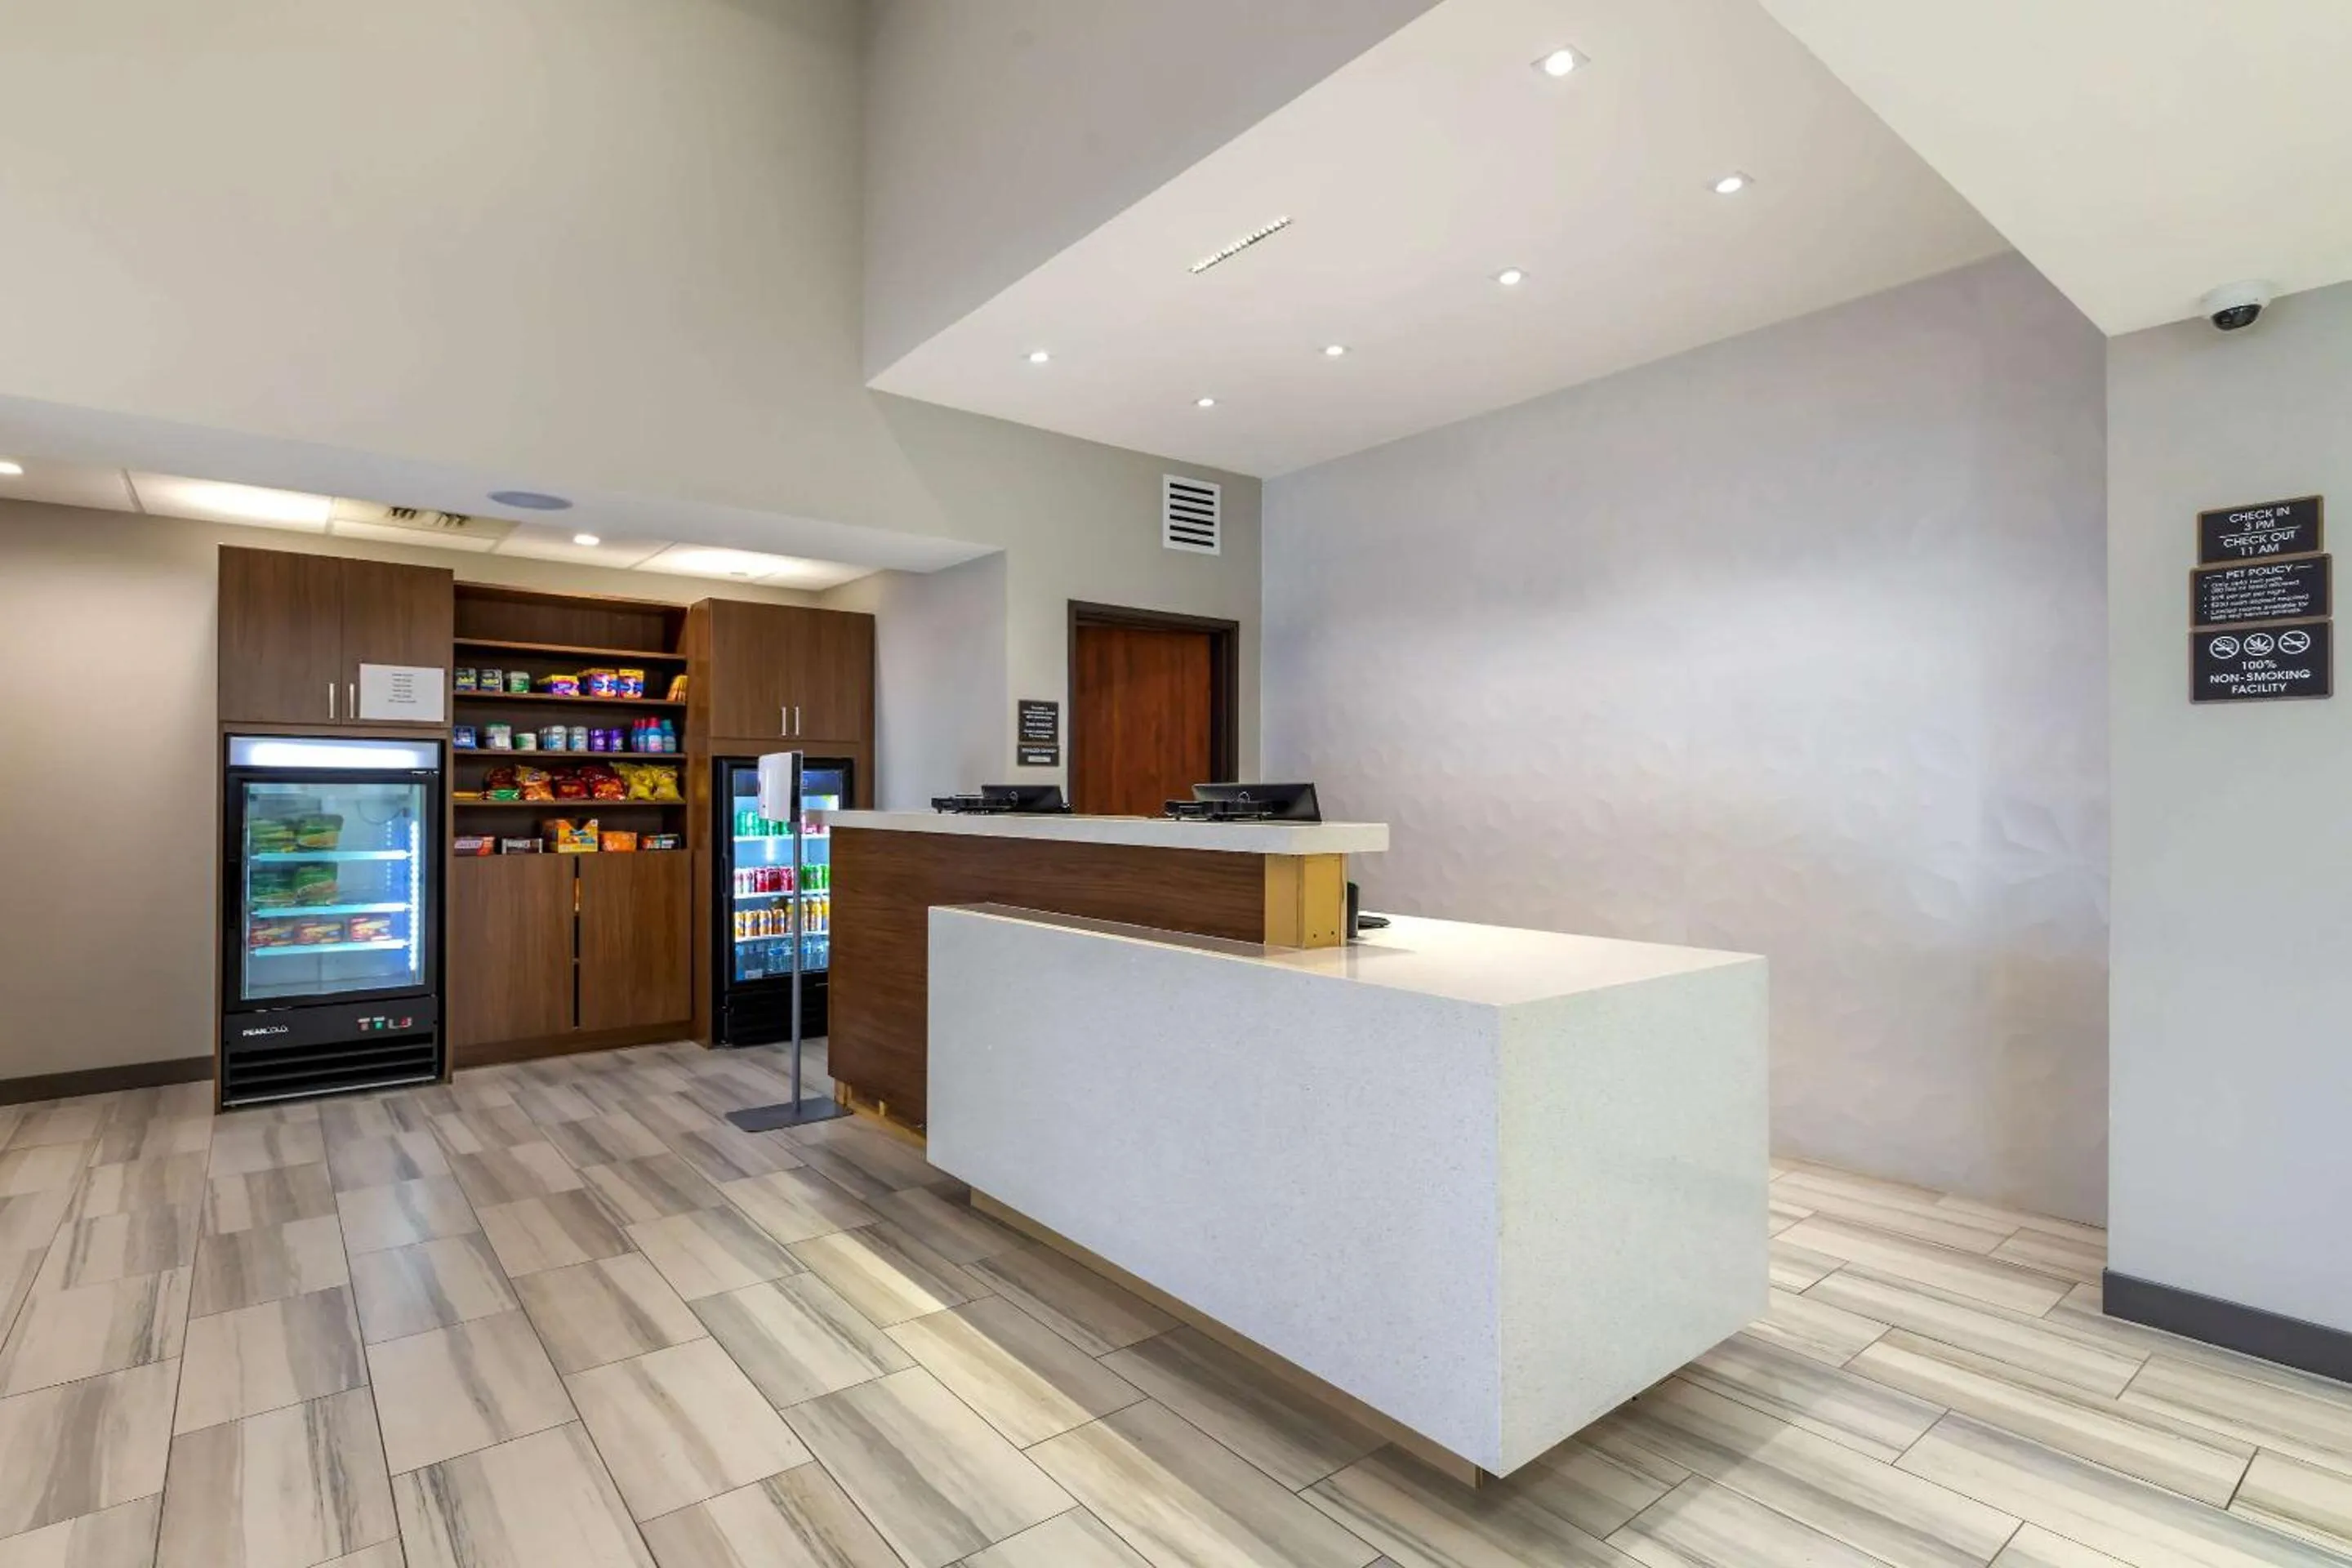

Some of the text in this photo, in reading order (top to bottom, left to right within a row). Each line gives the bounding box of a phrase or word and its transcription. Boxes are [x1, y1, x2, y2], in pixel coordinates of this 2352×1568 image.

[2229, 506, 2290, 523] CHECK IN
[2244, 519, 2274, 531] 3 PM
[2223, 530, 2296, 548] CHECK OUT
[2241, 543, 2279, 555] 11 AM
[2226, 564, 2292, 579] PET POLICY
[2242, 660, 2278, 670] 100%
[2210, 669, 2311, 684] NON-SMOKING
[2232, 683, 2287, 693] FACILITY
